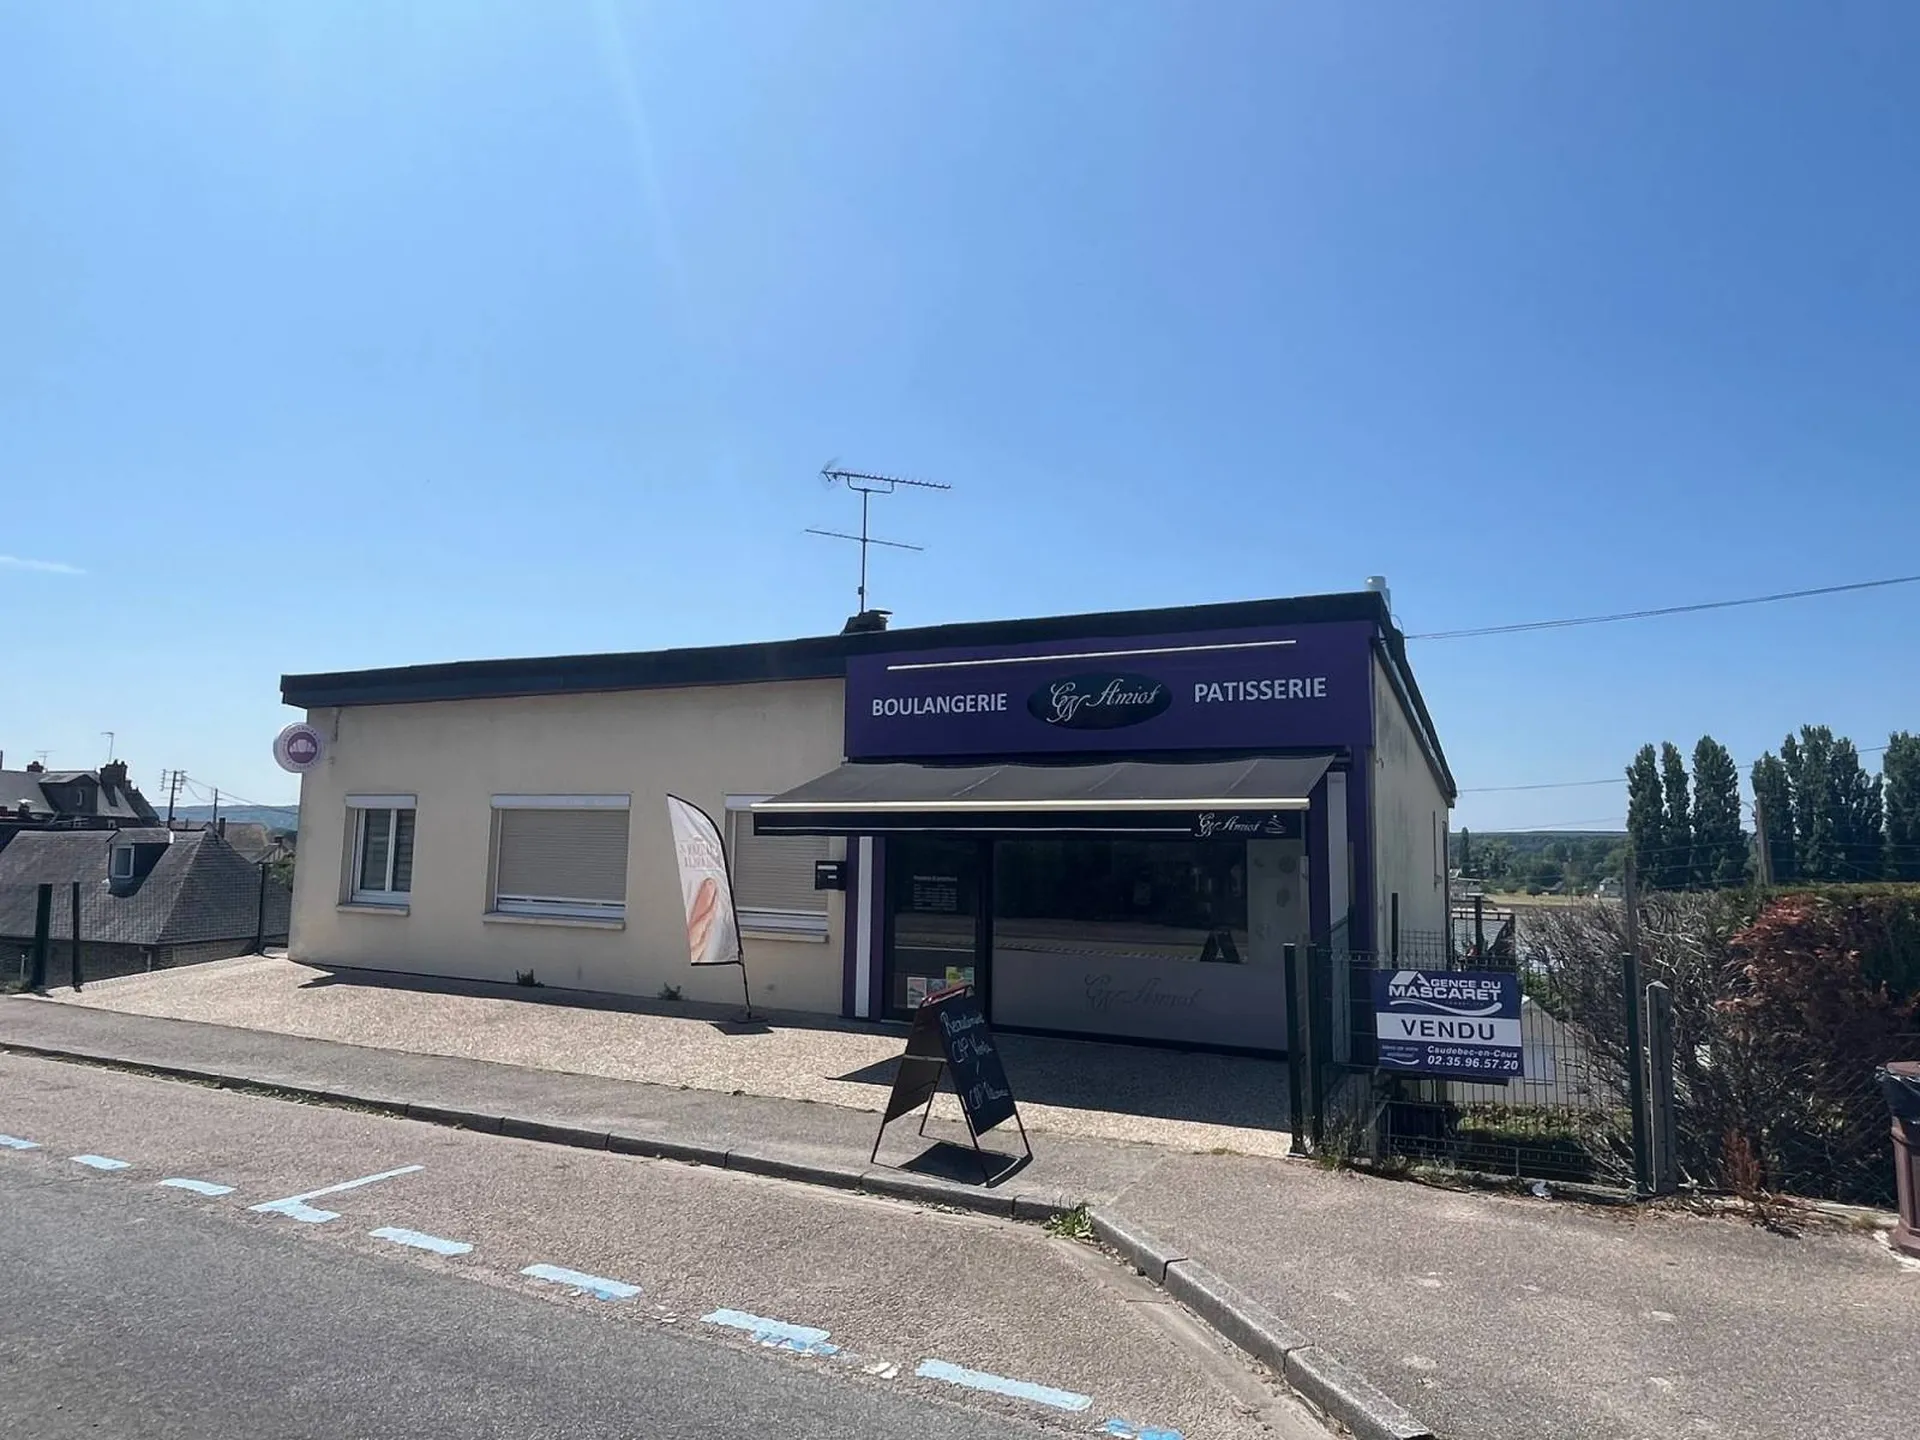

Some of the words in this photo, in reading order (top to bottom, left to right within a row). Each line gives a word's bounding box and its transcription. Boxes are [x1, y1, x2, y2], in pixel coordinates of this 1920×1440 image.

[1086, 678, 1162, 707] Amiot
[1194, 677, 1327, 703] PATISSERIE
[872, 692, 1007, 716] BOULANGERIE
[1389, 985, 1501, 1001] MASCARET
[1480, 980, 1501, 990] DU
[1401, 1019, 1496, 1042] VENDU
[1427, 1045, 1518, 1058] Caudebec-en-Caux
[1427, 1056, 1519, 1070] 02.35.96.57.20
